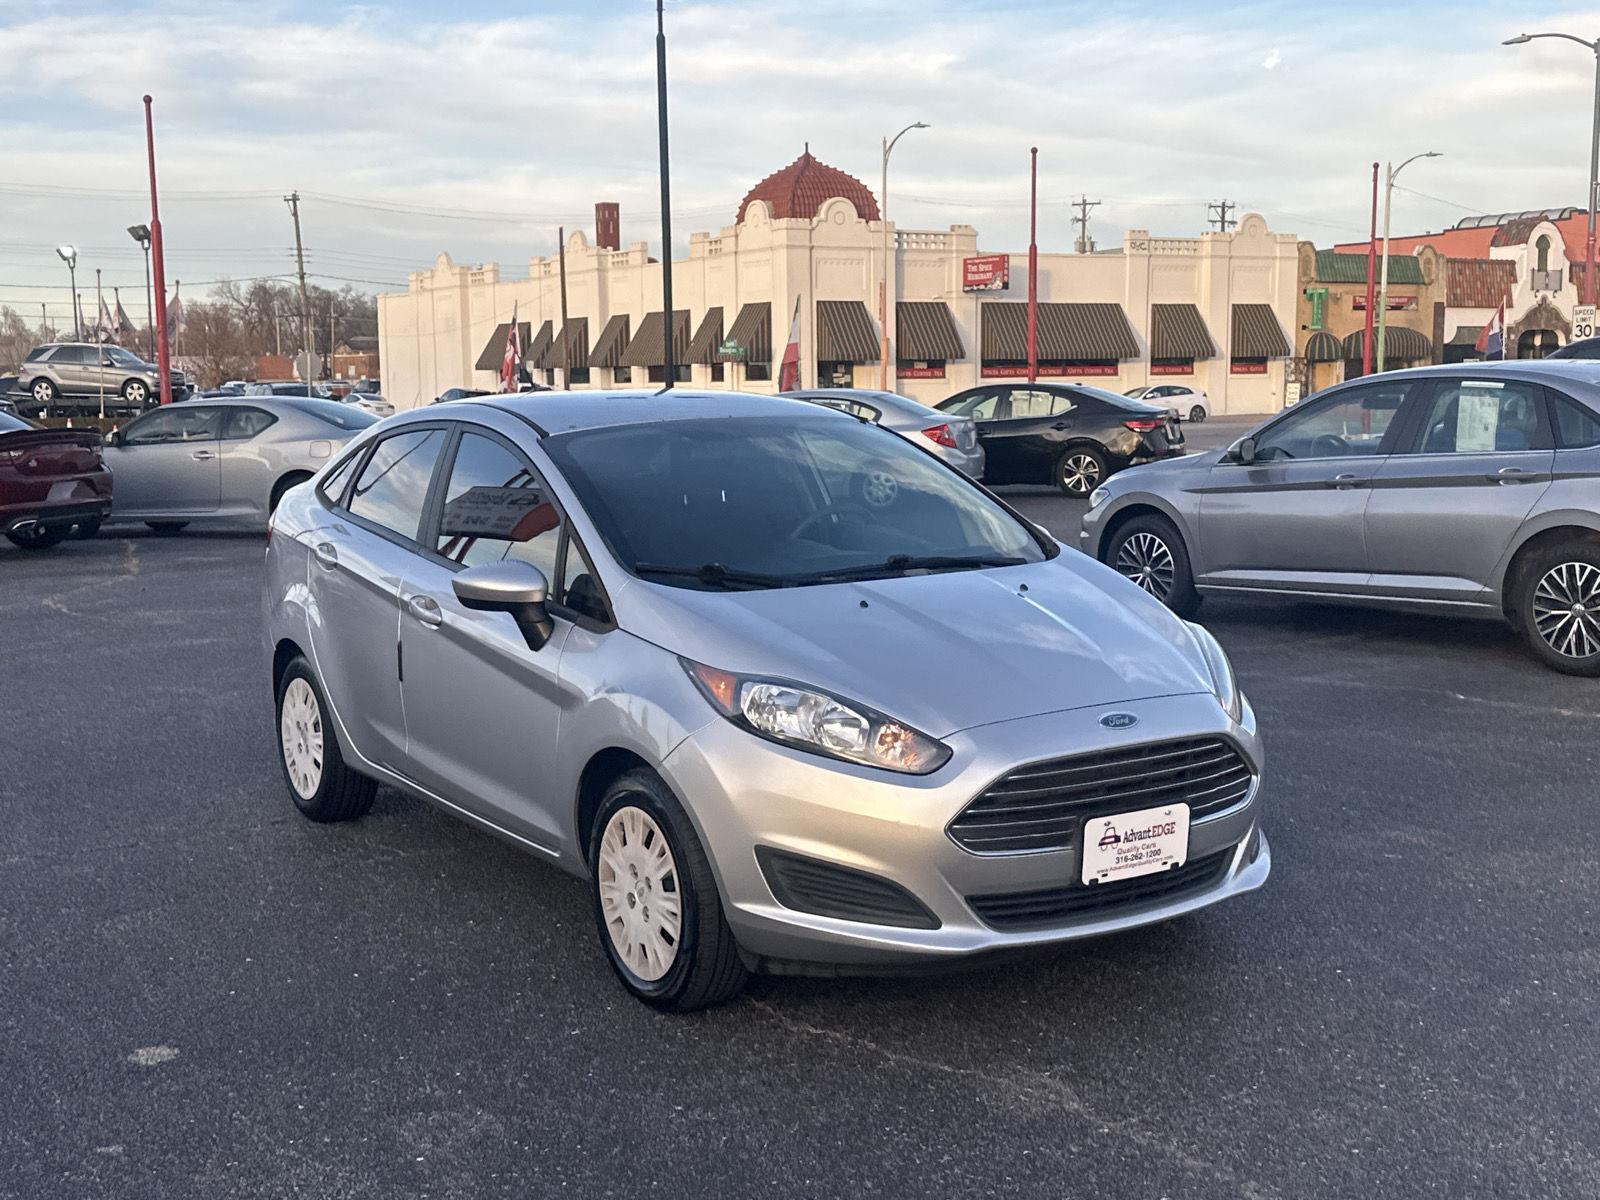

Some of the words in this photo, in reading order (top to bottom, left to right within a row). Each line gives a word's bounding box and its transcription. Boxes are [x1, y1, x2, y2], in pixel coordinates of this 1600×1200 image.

[1574, 324, 1592, 337] 30
[1108, 715, 1129, 726] Ford
[1123, 821, 1176, 844] AdvantEDGE
[1117, 843, 1140, 855] Quality
[1141, 842, 1157, 851] Cars
[1115, 848, 1162, 864] 316-262-1200
